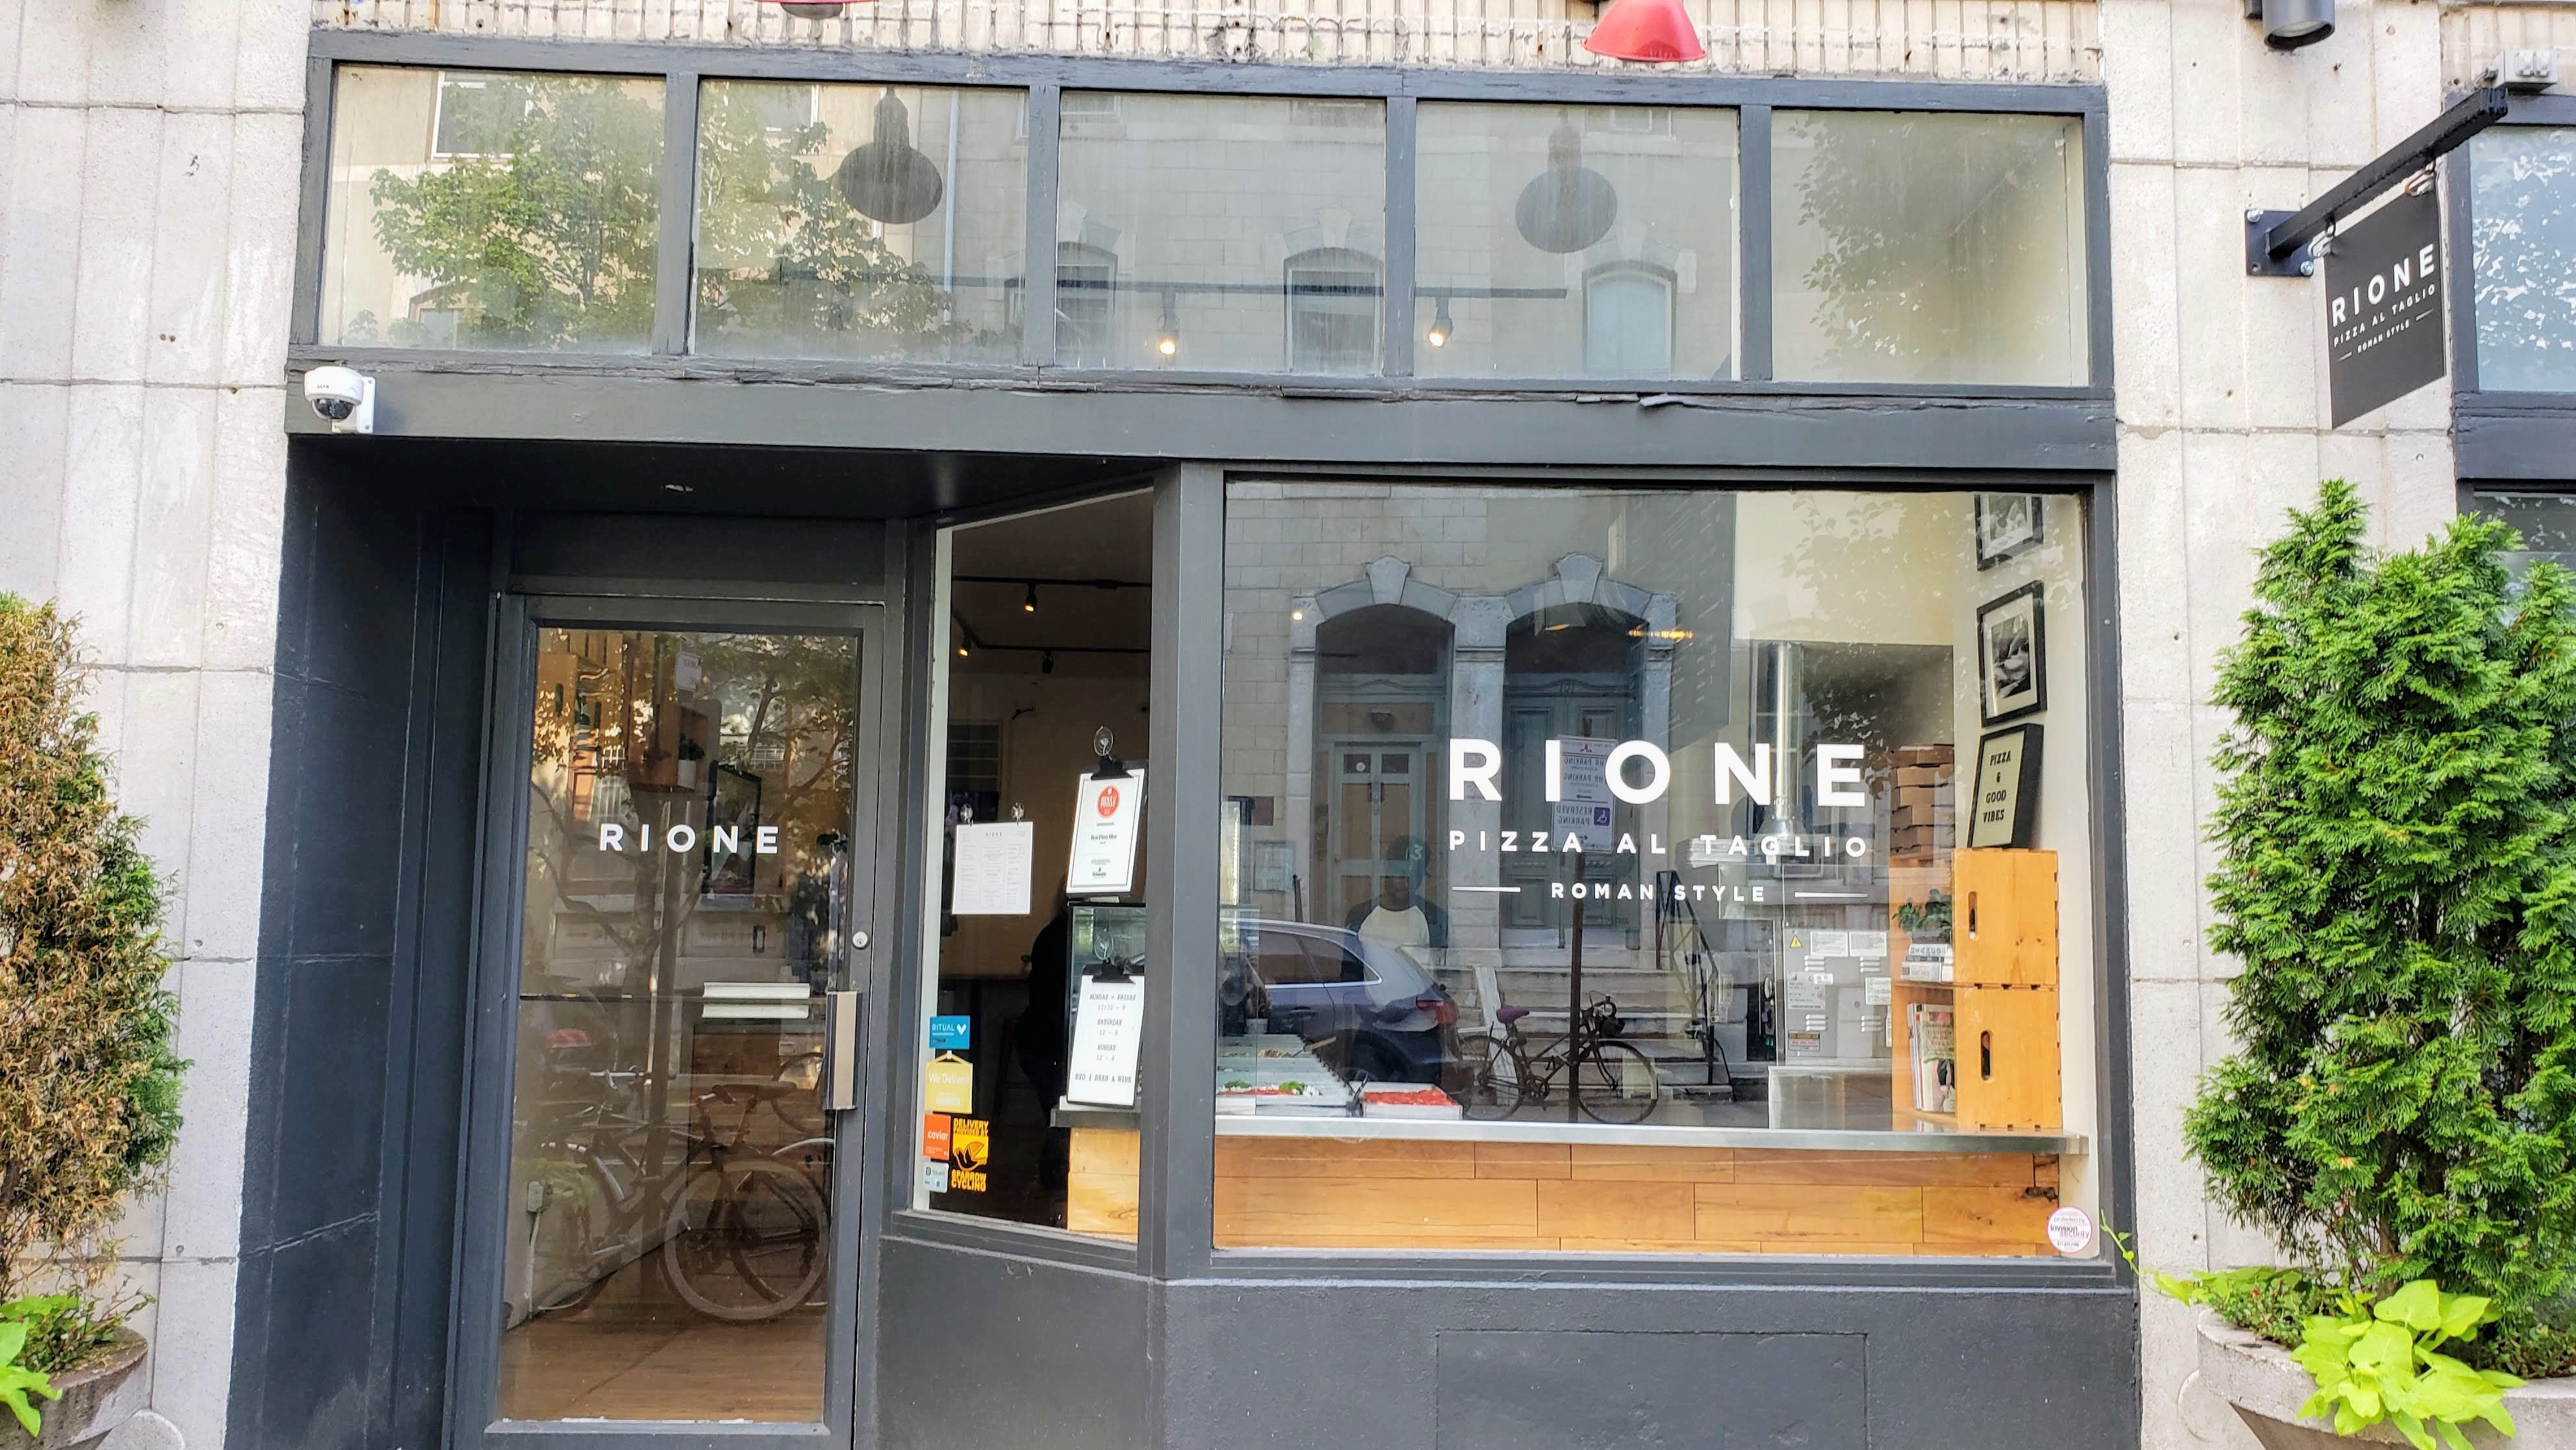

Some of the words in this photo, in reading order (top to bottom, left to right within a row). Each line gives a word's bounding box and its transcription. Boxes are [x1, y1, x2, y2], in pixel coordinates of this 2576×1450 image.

[2331, 243, 2435, 327] RIONE
[2334, 322, 2366, 348] PIZZA
[2372, 312, 2385, 327] AL
[2391, 283, 2435, 316] TAGLIO
[2357, 333, 2383, 353] ROMAN
[2386, 319, 2410, 338] STYLE
[1990, 750, 2011, 766] PIZZA
[1449, 738, 1865, 808] RIONE
[1985, 789, 2006, 804] GOOD
[1983, 809, 2004, 823] VIBES
[598, 823, 778, 854] RIONE
[1449, 830, 1582, 853] PIZZA
[1616, 833, 1666, 854] AL
[1700, 834, 1866, 858] TAGLIO
[1551, 882, 1653, 900] ROMAN
[1674, 885, 1764, 902] STYLE
[932, 1023, 955, 1032] RITUAL
[927, 1130, 949, 1141] caviar
